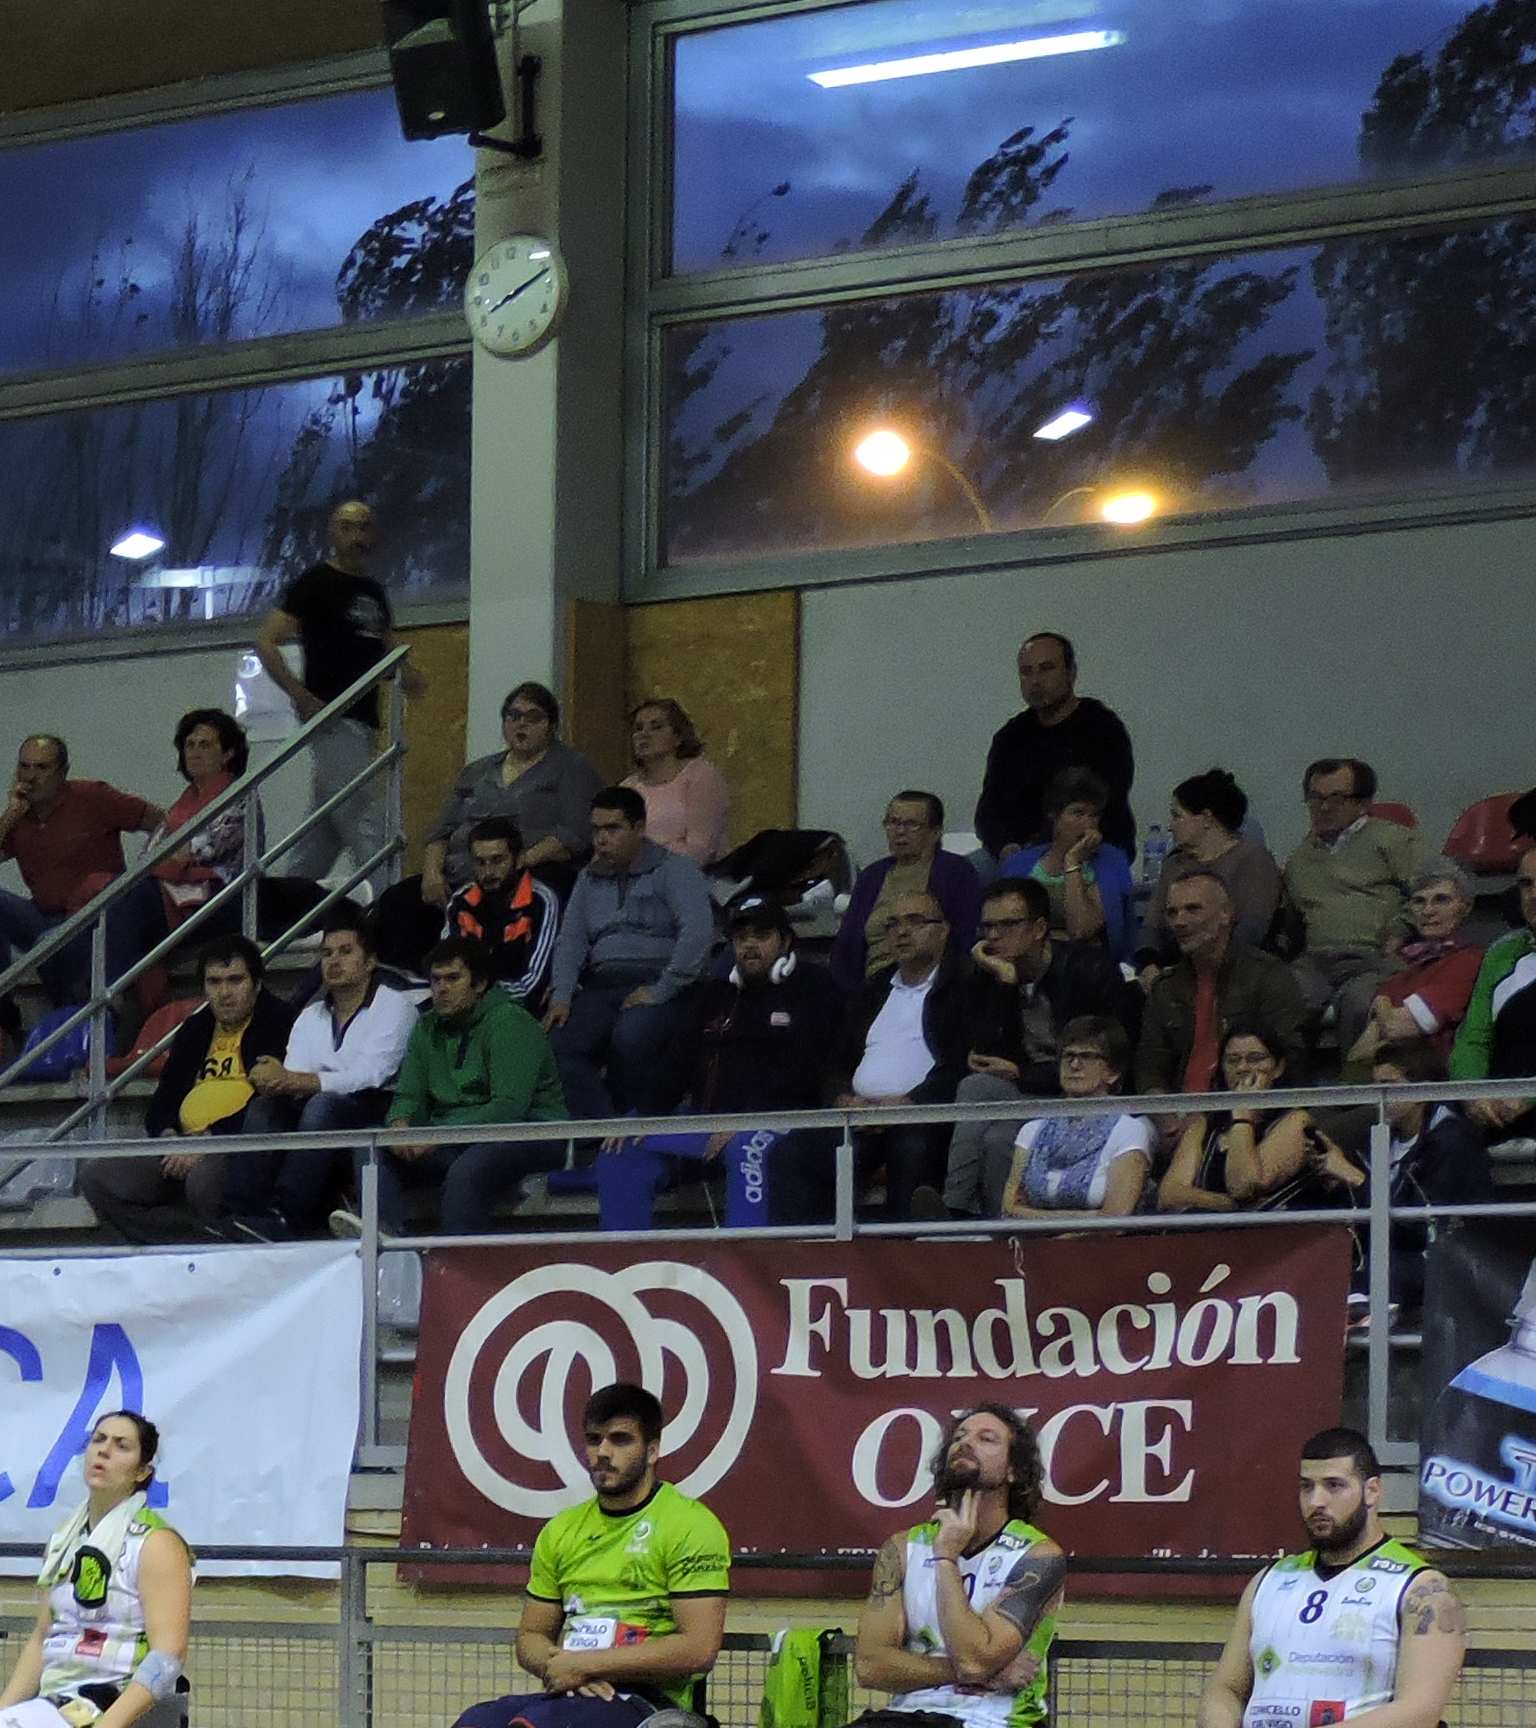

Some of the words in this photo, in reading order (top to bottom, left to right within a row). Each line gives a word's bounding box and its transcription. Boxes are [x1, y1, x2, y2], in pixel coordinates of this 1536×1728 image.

[770, 1263, 1302, 1380] Fundación
[850, 1398, 1195, 1509] OCE
[1424, 1460, 1536, 1521] POWER
[1298, 1589, 1329, 1625] 8
